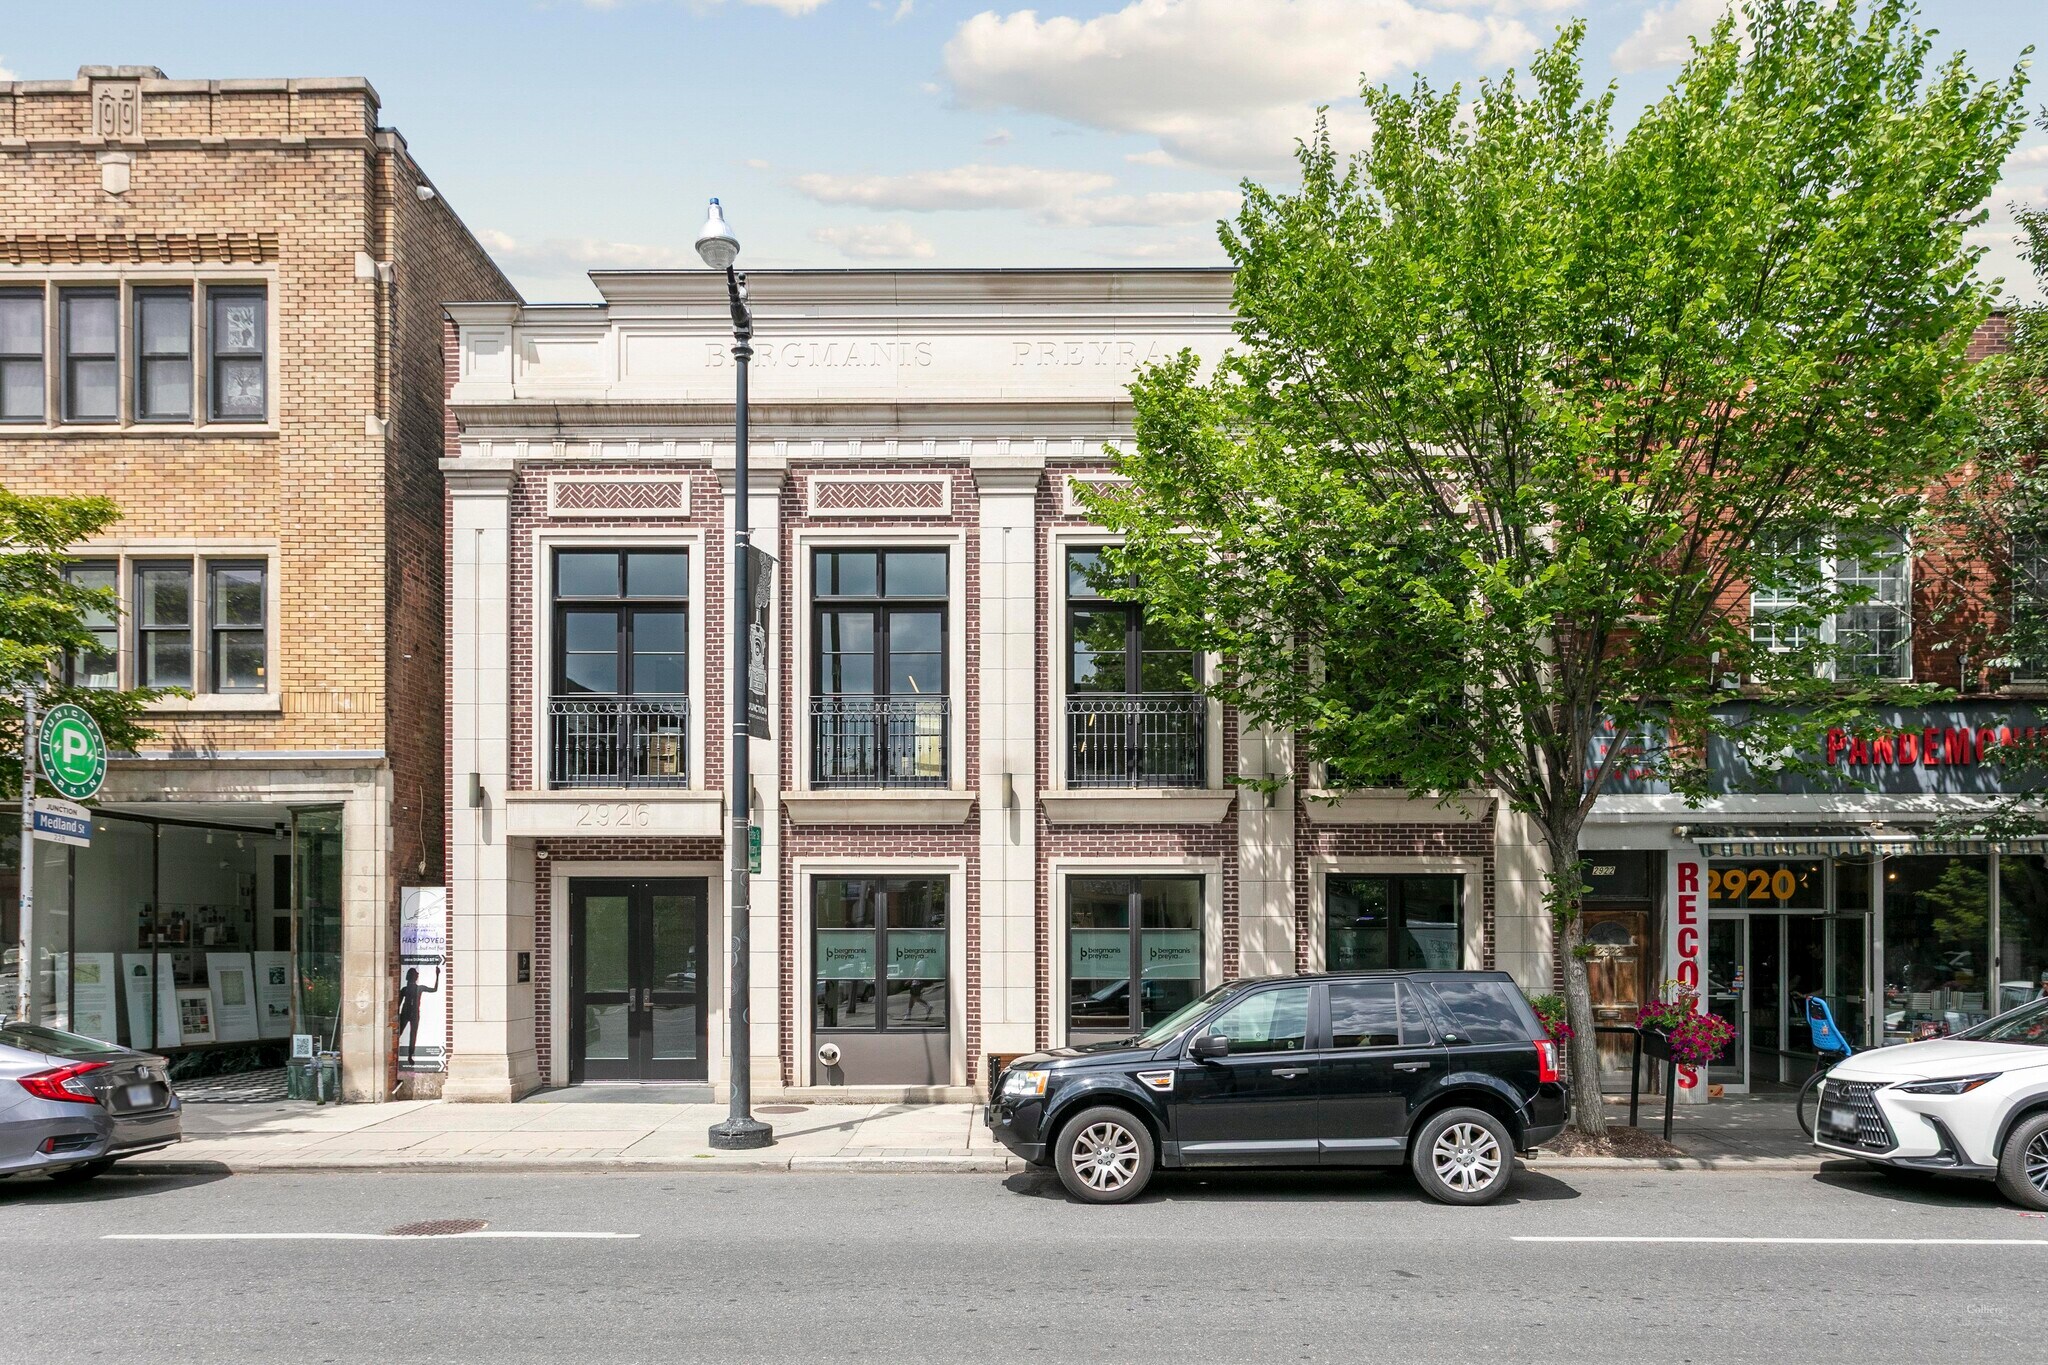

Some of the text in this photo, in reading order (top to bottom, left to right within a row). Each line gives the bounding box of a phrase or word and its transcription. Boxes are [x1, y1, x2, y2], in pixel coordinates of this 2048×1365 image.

[97, 102, 134, 136] 1919
[43, 708, 104, 755] MUNICIPAL
[63, 727, 88, 764] P
[43, 752, 104, 795] PARKING
[46, 804, 78, 816] JUNCTION
[576, 803, 650, 827] 2926
[39, 814, 85, 834] Medland St
[53, 834, 66, 843] 228
[1594, 867, 1614, 875] 2922
[1708, 869, 1796, 900] 2920
[834, 947, 866, 955] bergmanis
[904, 947, 936, 955] bergmanis
[1088, 947, 1120, 955] bergmanis
[1158, 947, 1190, 955] bergmanis
